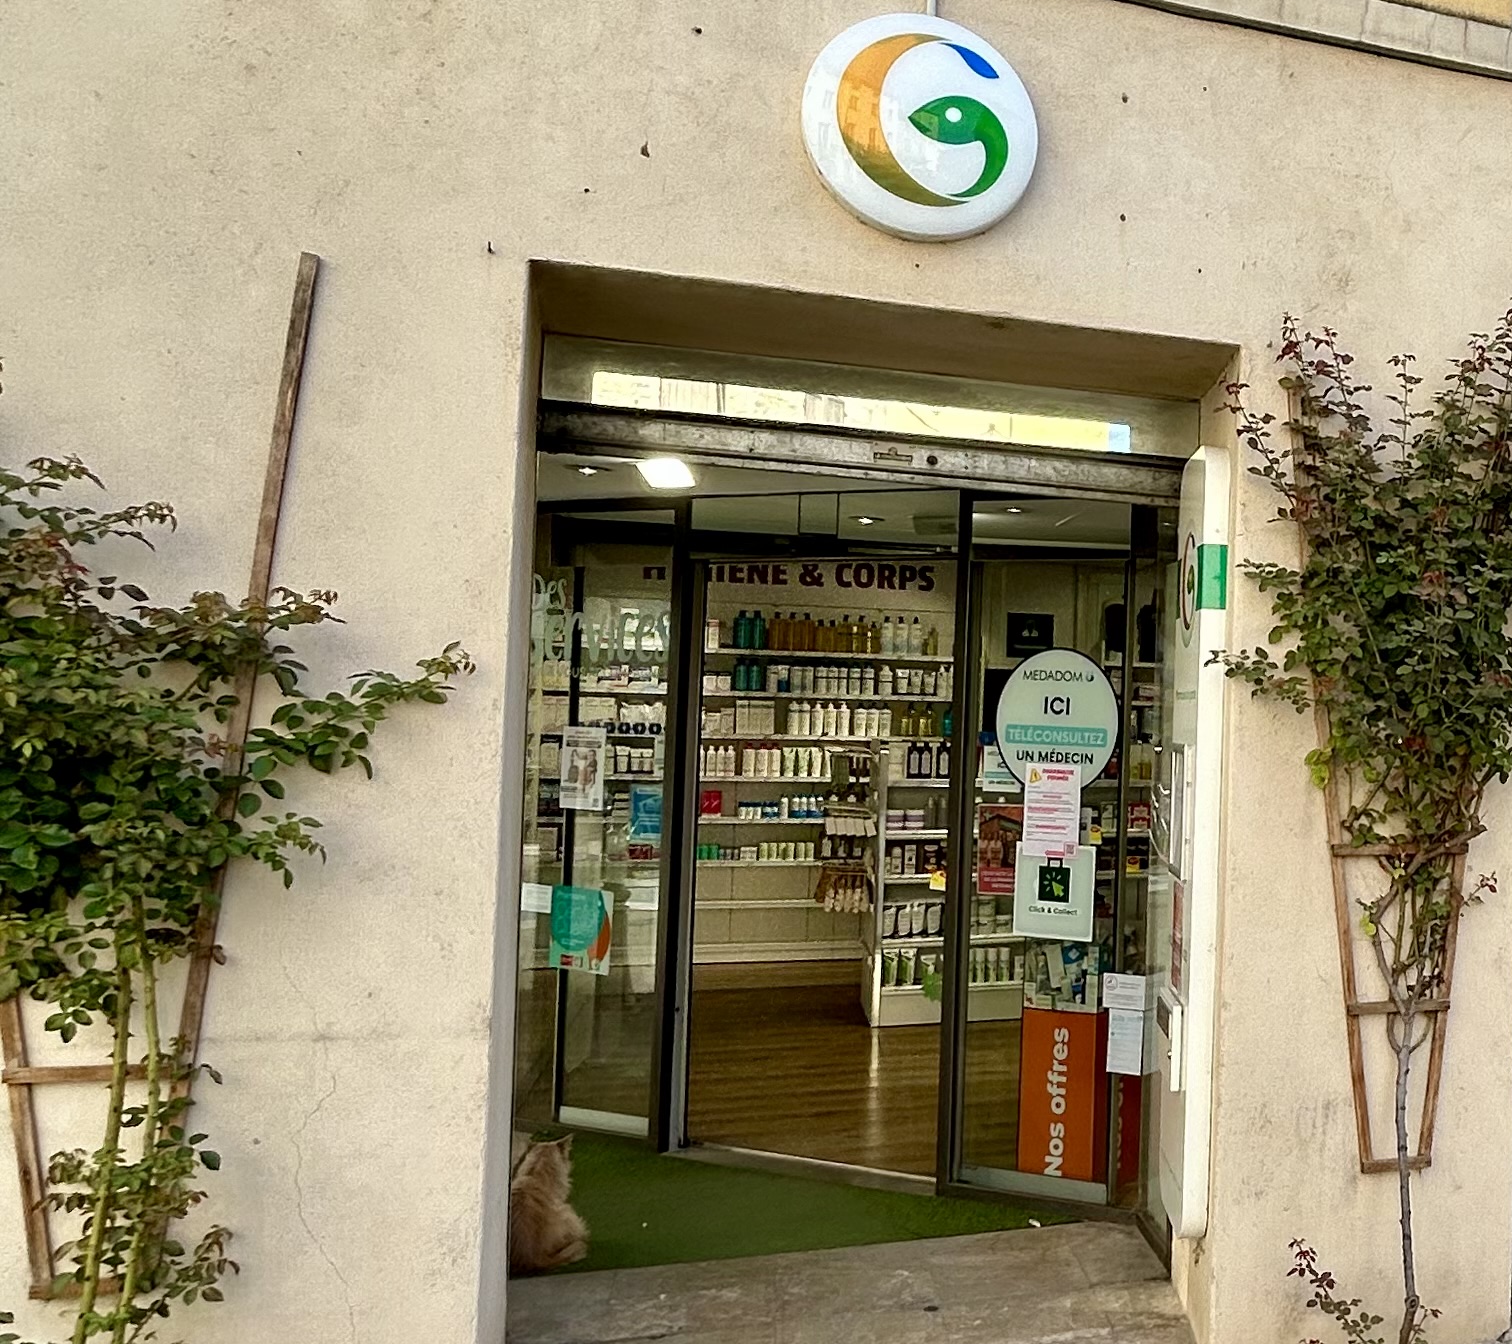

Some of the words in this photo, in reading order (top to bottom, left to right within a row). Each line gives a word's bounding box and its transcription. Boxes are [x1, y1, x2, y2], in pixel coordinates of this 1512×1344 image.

[799, 563, 825, 587] &
[835, 562, 936, 592] CORPS
[1022, 669, 1083, 683] MEDADOM
[1043, 696, 1071, 716] ICI
[1007, 726, 1105, 745] TÉLÉCONSULTEZ
[1016, 750, 1035, 762] UN
[1038, 748, 1094, 765] MÉDECIN
[1046, 1027, 1071, 1115] offres
[1043, 1121, 1066, 1177] Nos
